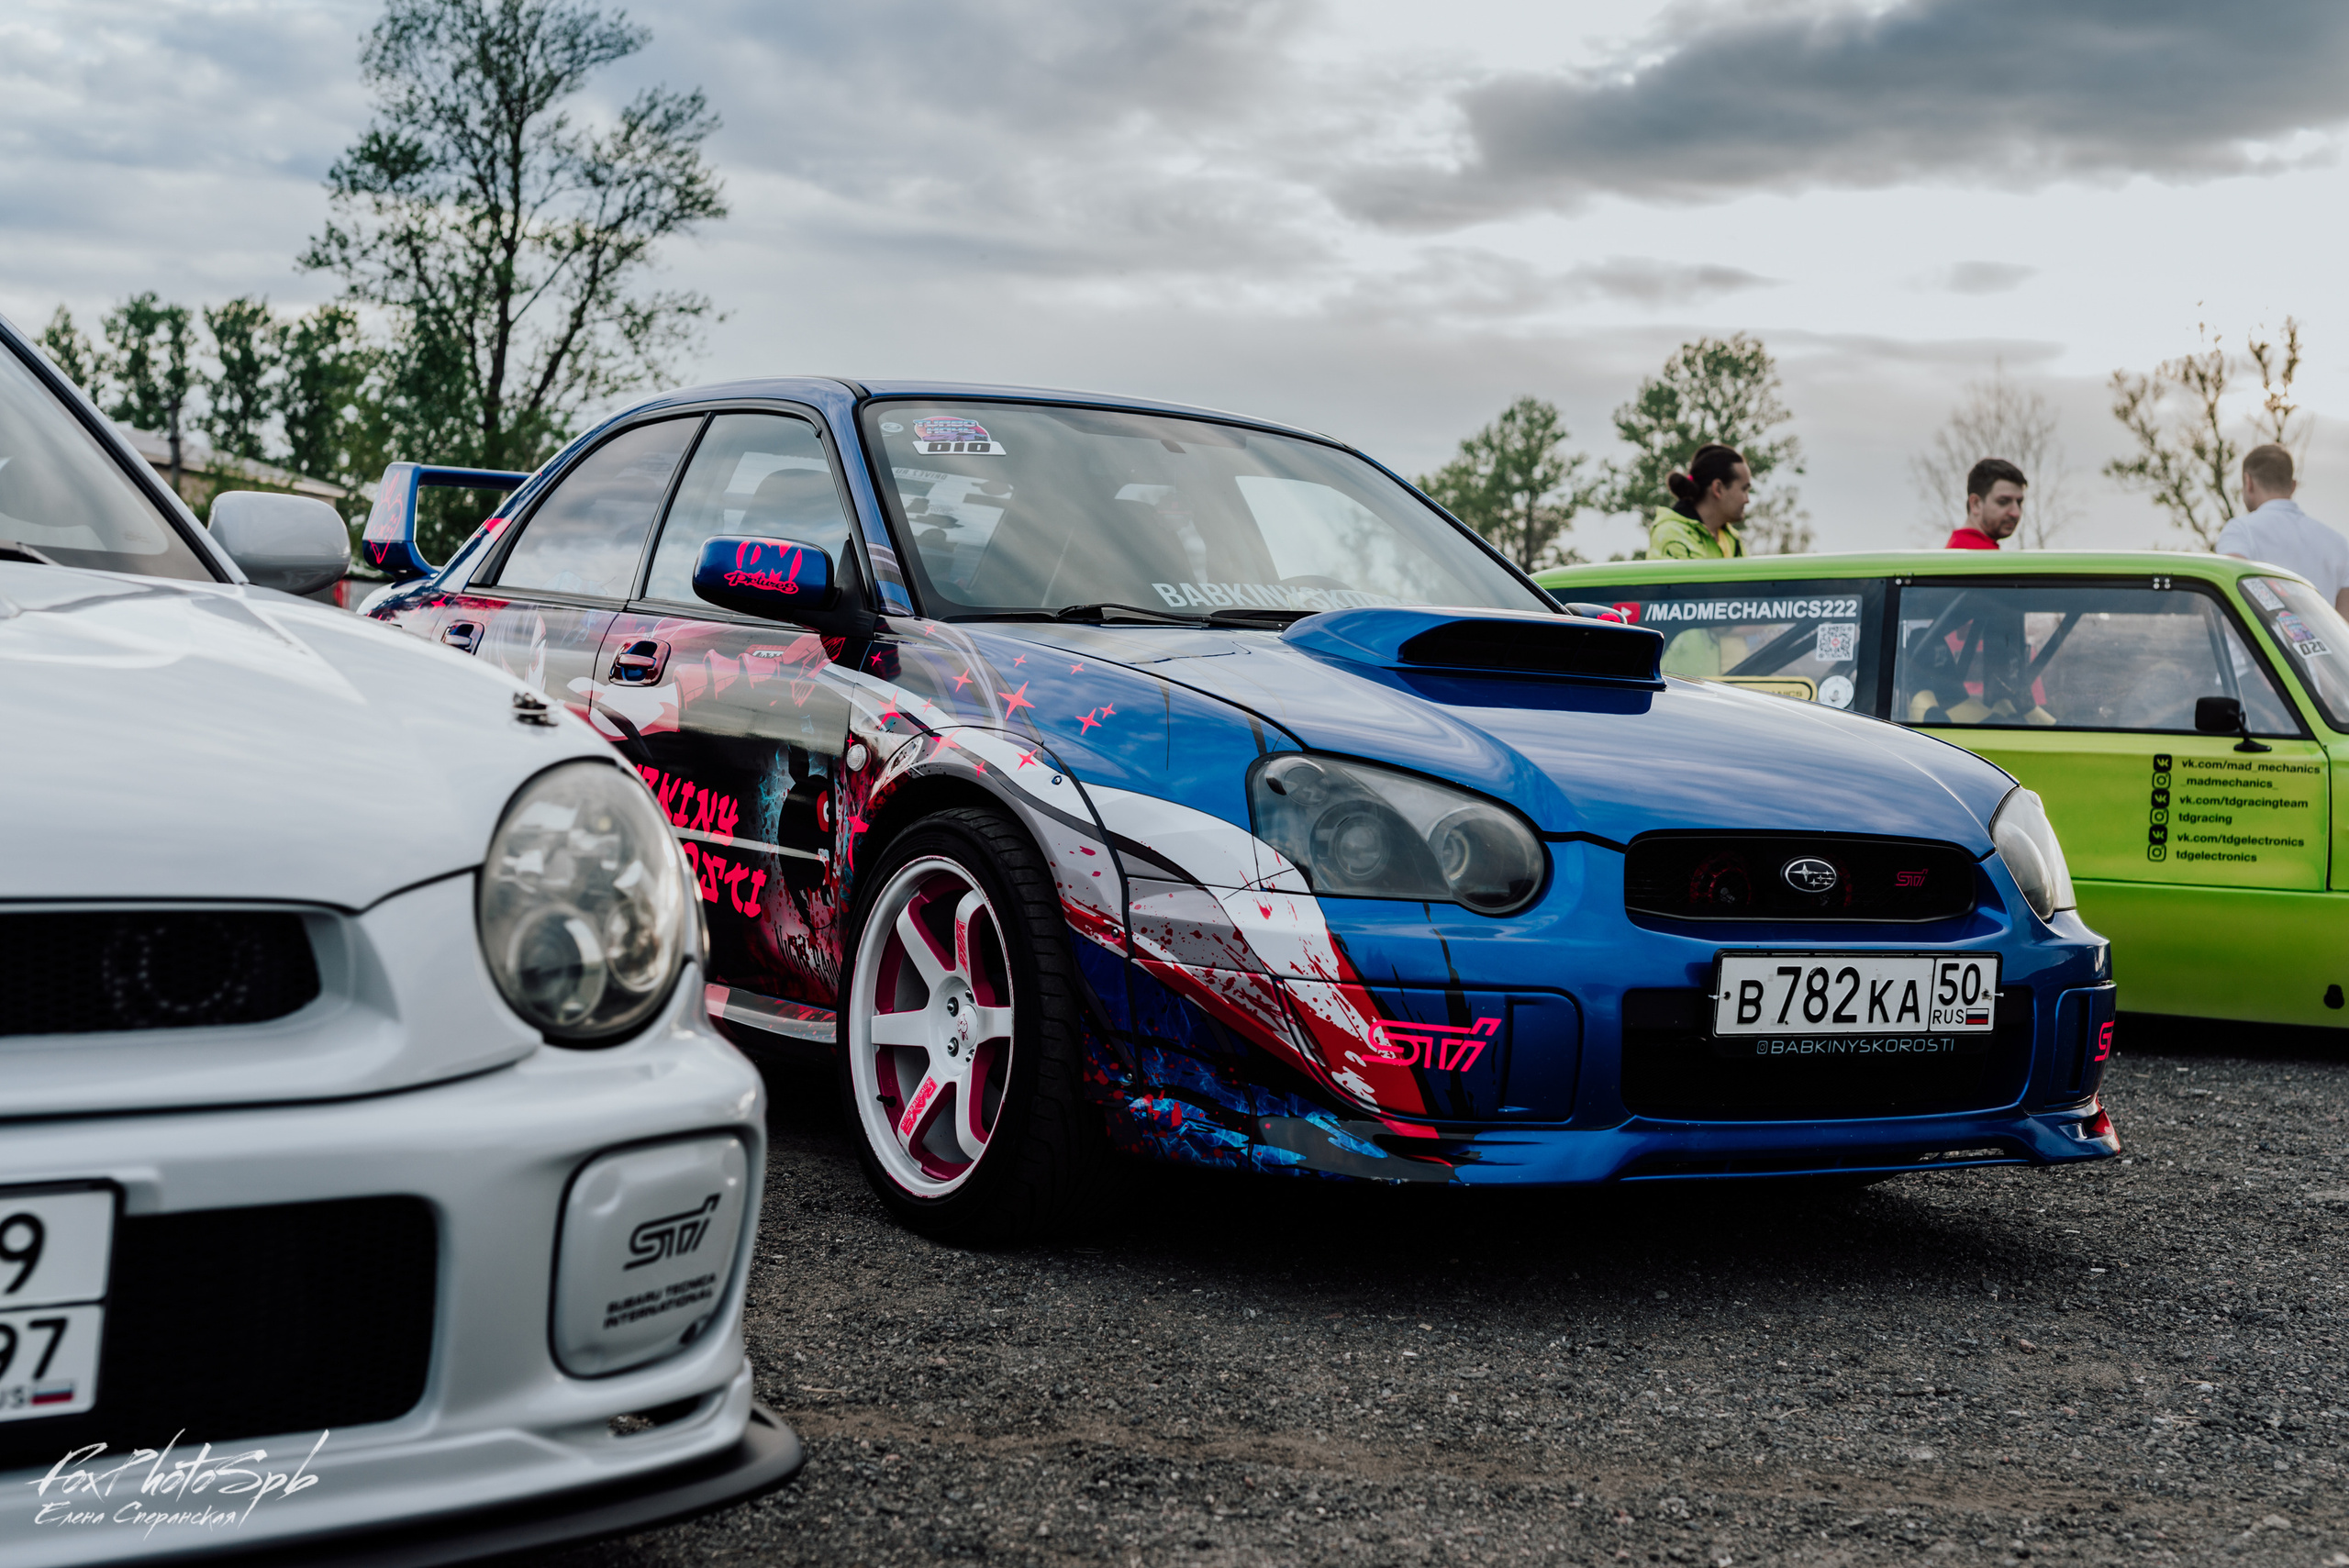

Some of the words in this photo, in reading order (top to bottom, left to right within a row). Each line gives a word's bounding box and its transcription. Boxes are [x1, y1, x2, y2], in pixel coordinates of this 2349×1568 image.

[927, 442, 991, 453] 010
[1645, 600, 1857, 621] /MADMECHANICS222
[2182, 759, 2321, 774] vk.com/mad_mechanics
[2180, 776, 2279, 791] _madmechanics_
[2179, 795, 2309, 809] vk.com/tdgracingteam
[2178, 813, 2233, 826] tdgracing
[2176, 832, 2305, 848] vk.com/tdgelectronics
[2176, 850, 2257, 862] tdgelectronics
[1938, 962, 1982, 1006] 50
[1932, 1009, 1965, 1025] RUS
